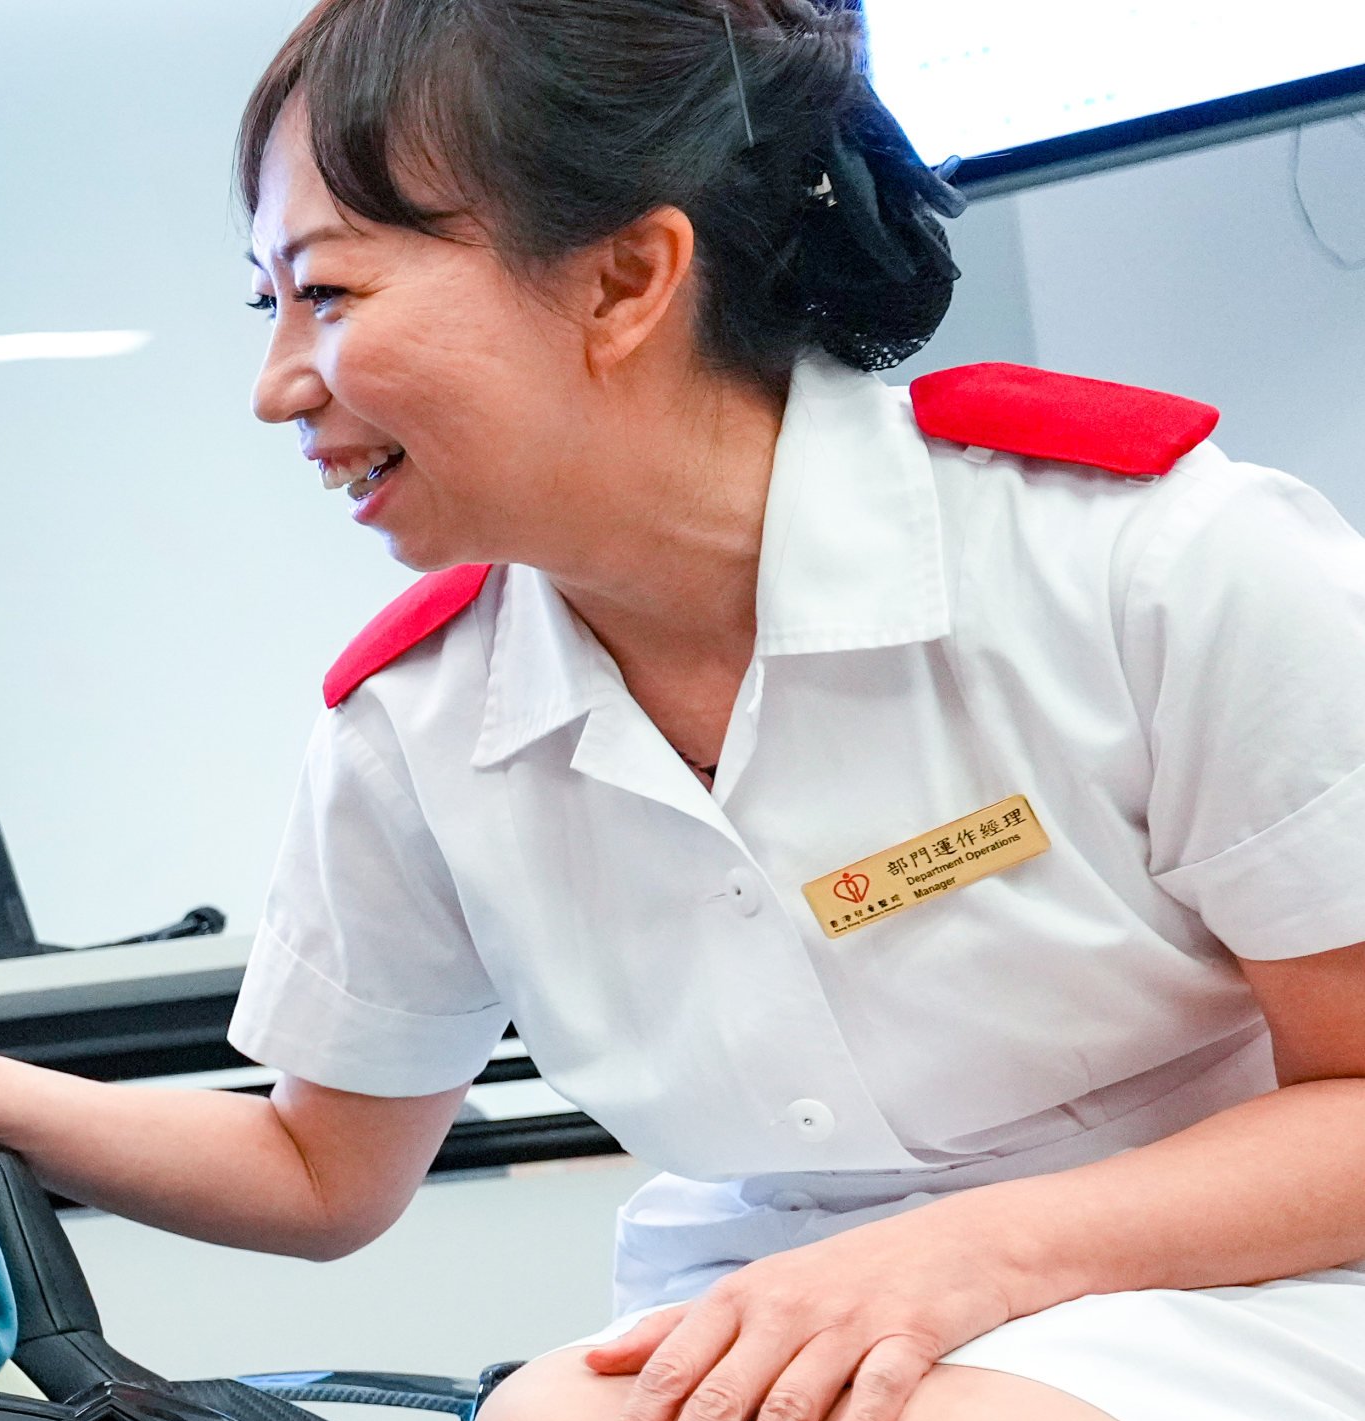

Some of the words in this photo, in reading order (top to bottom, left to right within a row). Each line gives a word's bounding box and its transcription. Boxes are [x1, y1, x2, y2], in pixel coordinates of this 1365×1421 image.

[886, 807, 1027, 877] 部門運作經理
[906, 856, 964, 886] Department
[965, 834, 1021, 863] Operations
[914, 876, 956, 900] Manager
